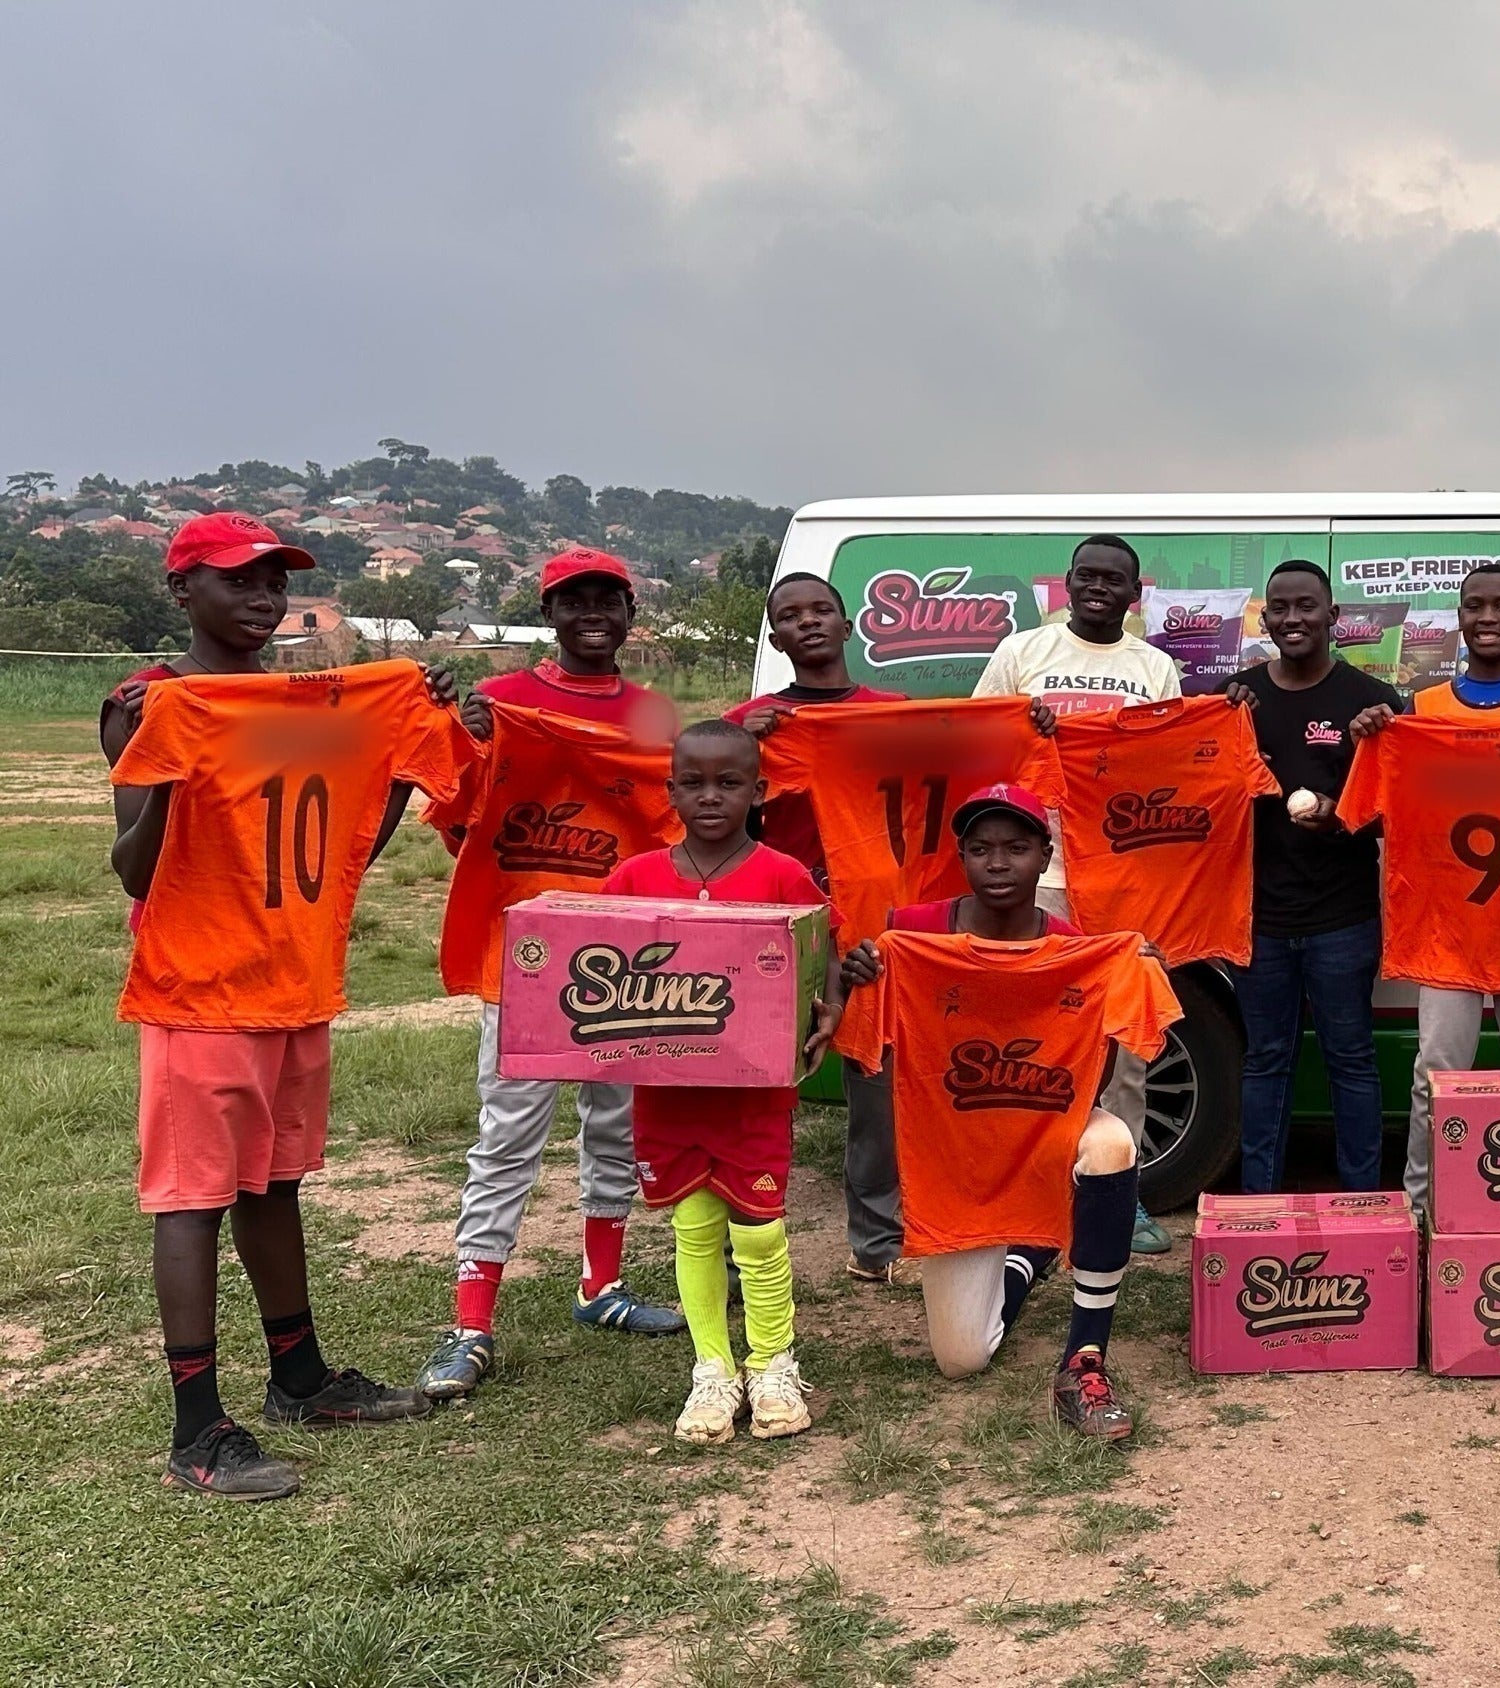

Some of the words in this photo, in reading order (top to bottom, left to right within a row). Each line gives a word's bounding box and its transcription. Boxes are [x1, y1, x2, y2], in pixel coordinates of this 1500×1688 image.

[1345, 562, 1404, 580] KEEP
[1366, 584, 1391, 595] BUT
[1395, 582, 1430, 594] KEEP
[864, 574, 1008, 636] Sumz
[1196, 665, 1240, 675] CHUTNEY
[1215, 654, 1240, 664] FRUIT
[289, 673, 346, 683] BASEBALL
[874, 667, 908, 683] Taste
[912, 664, 936, 681] The
[1043, 675, 1152, 699] BASEBALL
[1304, 720, 1343, 741] Sumz
[876, 773, 949, 869] 11
[1104, 793, 1211, 836] Sumz
[259, 774, 329, 910] 10
[499, 803, 615, 861] Sumz
[568, 945, 728, 1014] Sumz
[725, 966, 742, 975] TM
[590, 1050, 625, 1062] Taste
[628, 1044, 653, 1057] The
[656, 1042, 720, 1058] Difference
[946, 1041, 1074, 1097] Sumz
[1241, 1258, 1366, 1313] Sumz
[1362, 1267, 1376, 1276] TM
[1261, 1340, 1287, 1350] Taste
[1291, 1334, 1309, 1344] The
[1312, 1330, 1360, 1344] Difference
